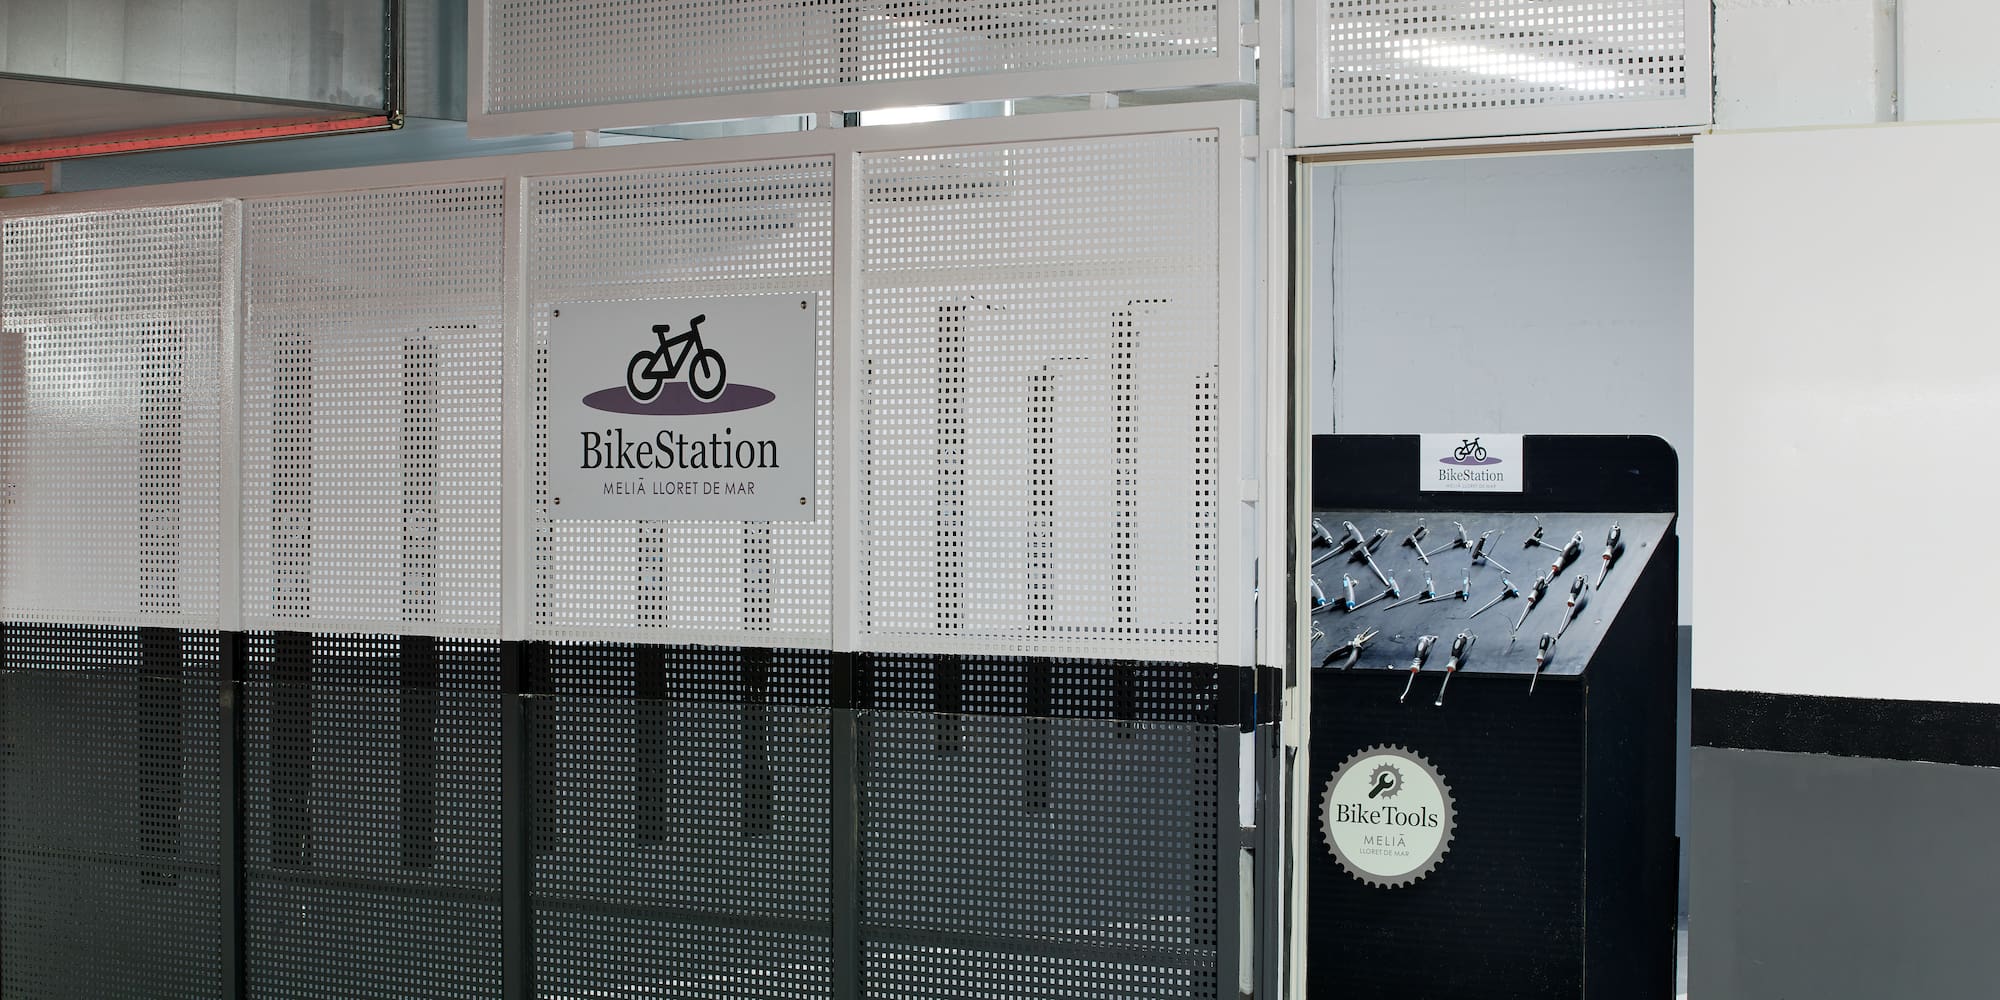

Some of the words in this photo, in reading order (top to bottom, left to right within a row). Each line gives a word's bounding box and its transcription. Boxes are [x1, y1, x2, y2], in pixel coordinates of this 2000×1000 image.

[580, 427, 780, 469] BikeStation
[1438, 468, 1504, 482] BikeStation
[652, 481, 699, 496] LLORET
[703, 481, 720, 495] DE
[724, 481, 755, 496] MAR
